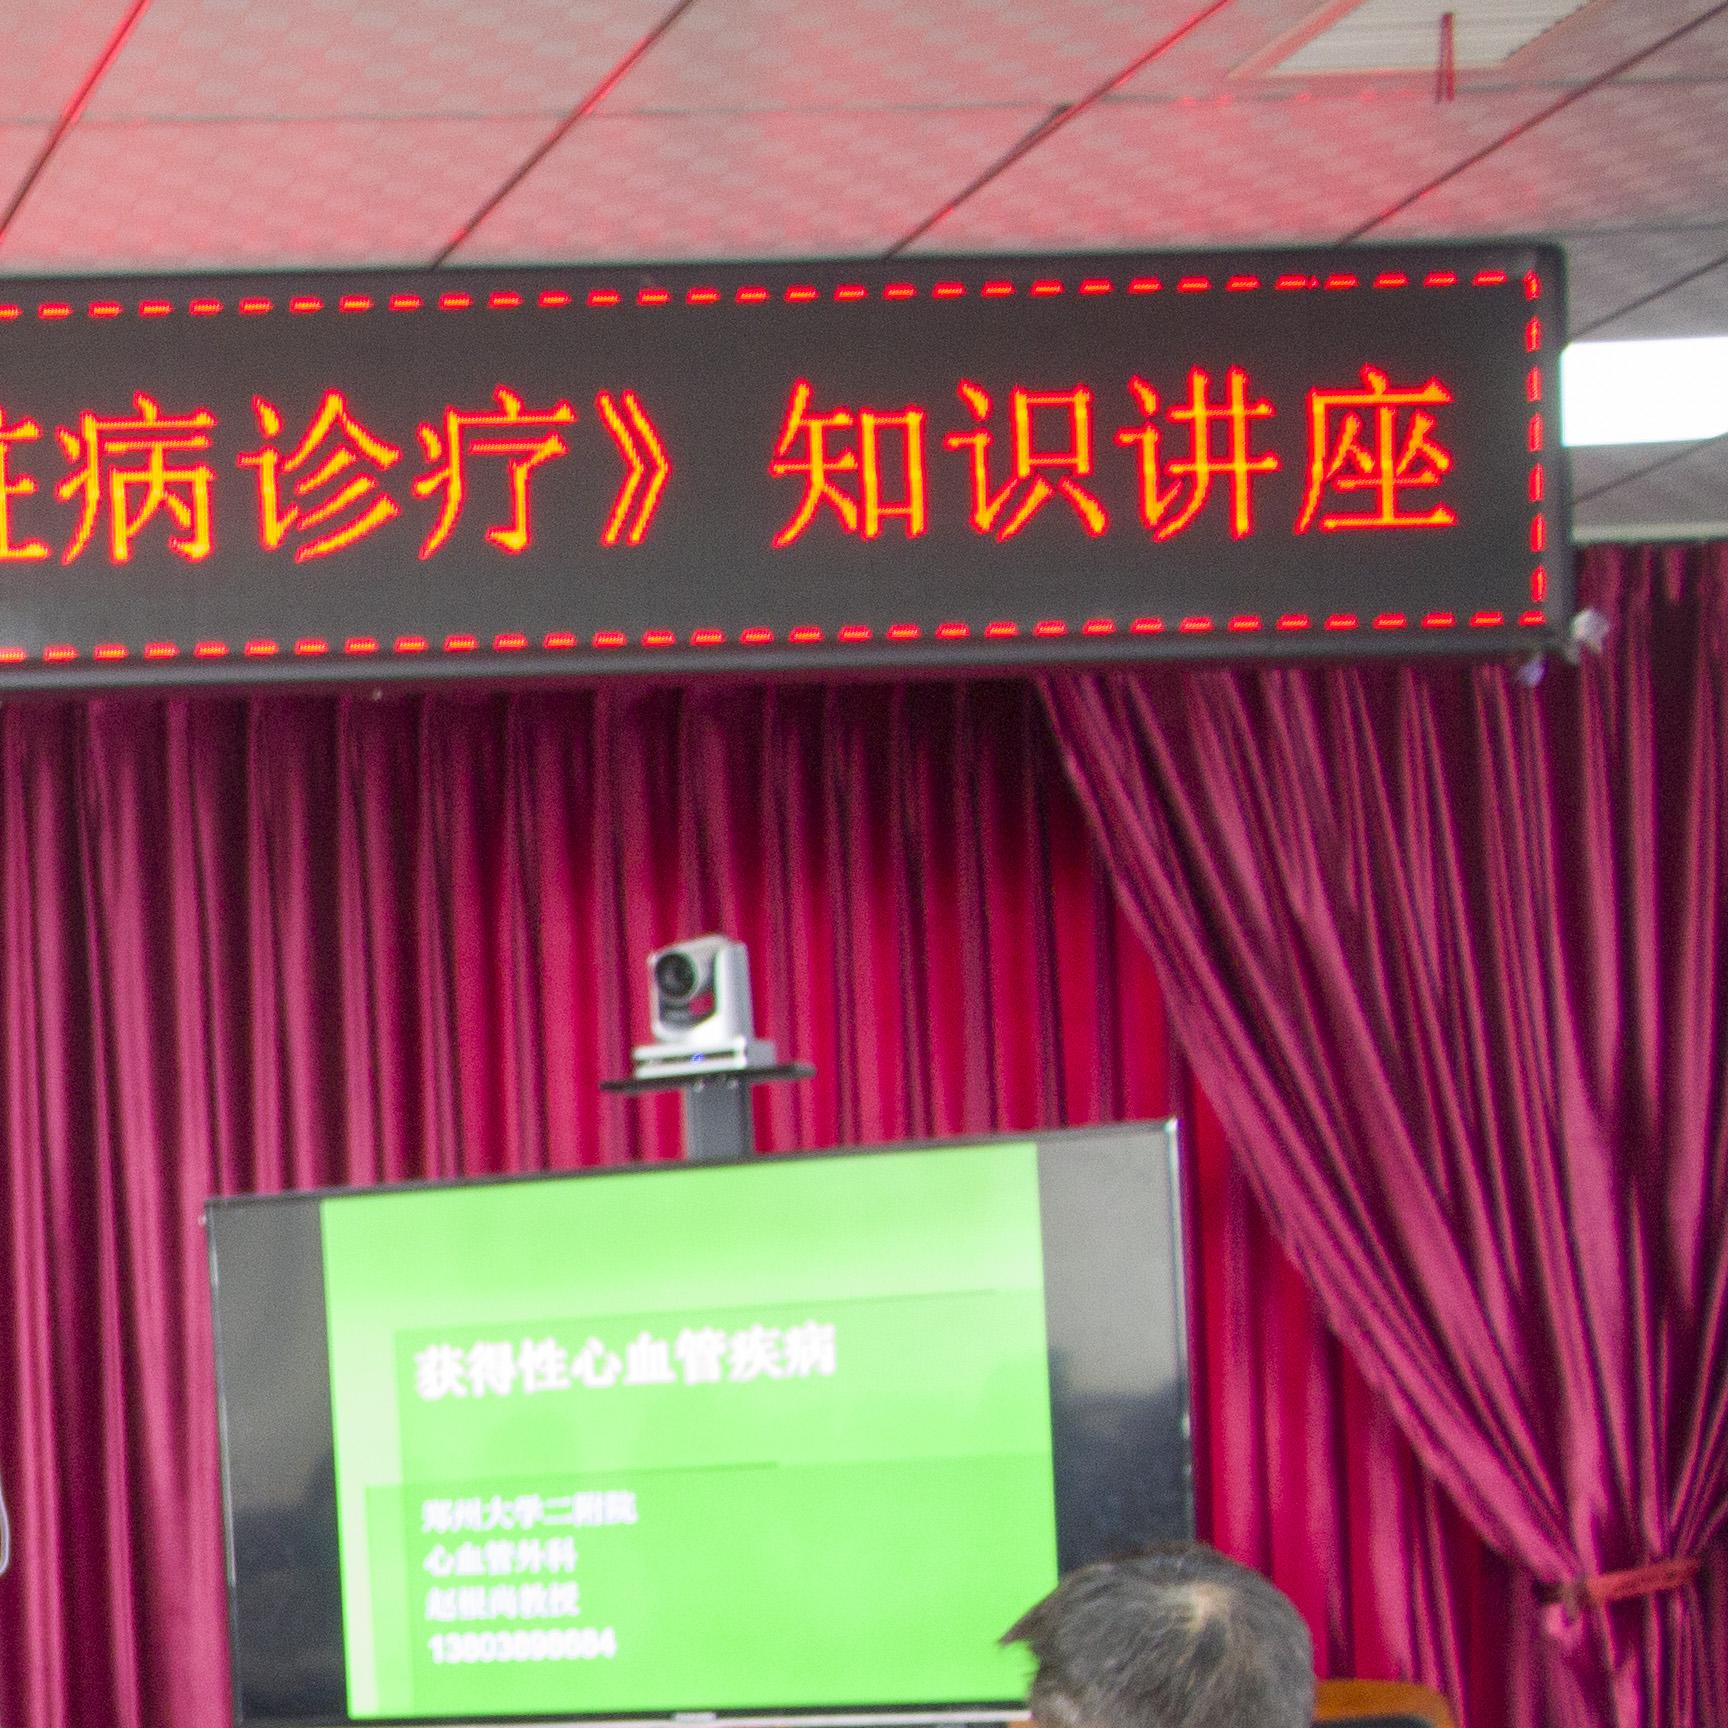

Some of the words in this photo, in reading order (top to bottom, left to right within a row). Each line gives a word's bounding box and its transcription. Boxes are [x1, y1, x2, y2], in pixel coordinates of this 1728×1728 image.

[414, 1320, 838, 1400] 获得性心血管疾病
[423, 1536, 578, 1577] 心血管外科
